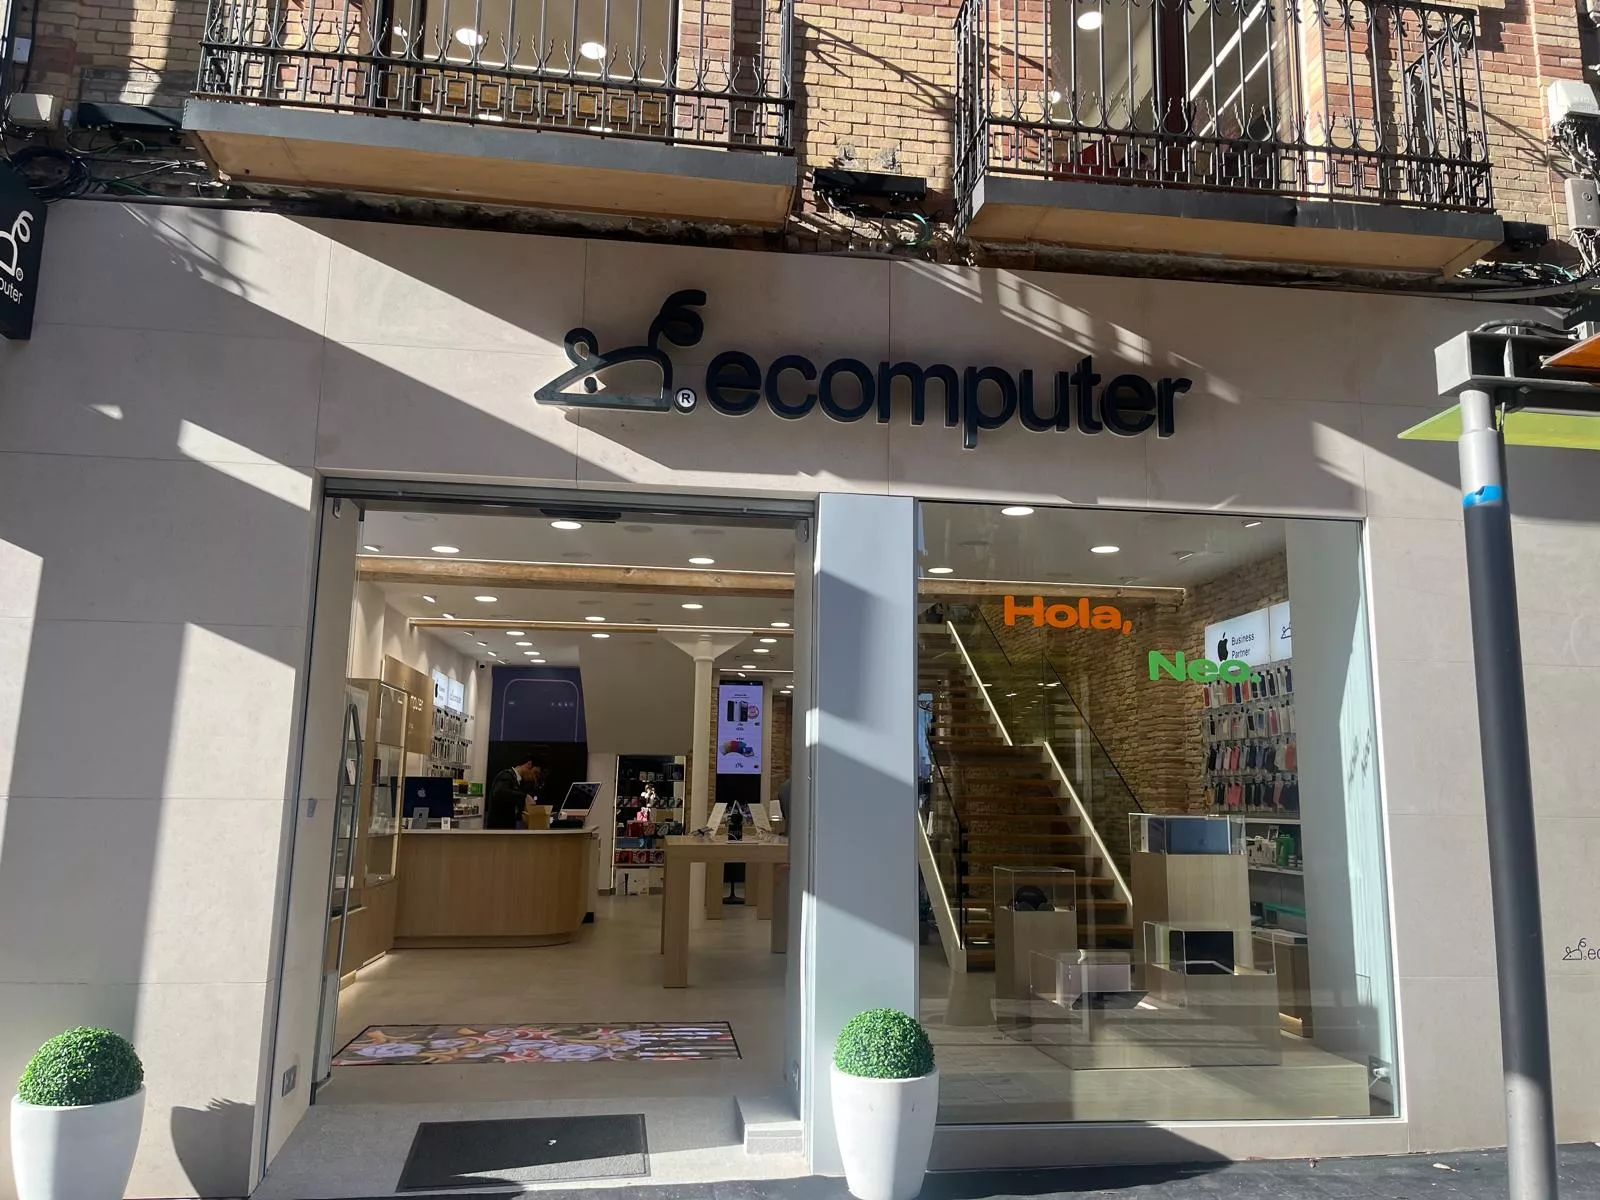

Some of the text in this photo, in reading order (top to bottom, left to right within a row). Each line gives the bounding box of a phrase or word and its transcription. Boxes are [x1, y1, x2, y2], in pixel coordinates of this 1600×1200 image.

[706, 351, 1193, 450] ecomputer
[1004, 595, 1132, 636] Hola,
[1231, 632, 1255, 646] Business
[1231, 648, 1251, 659] Partner
[1148, 650, 1262, 683] Neo.
